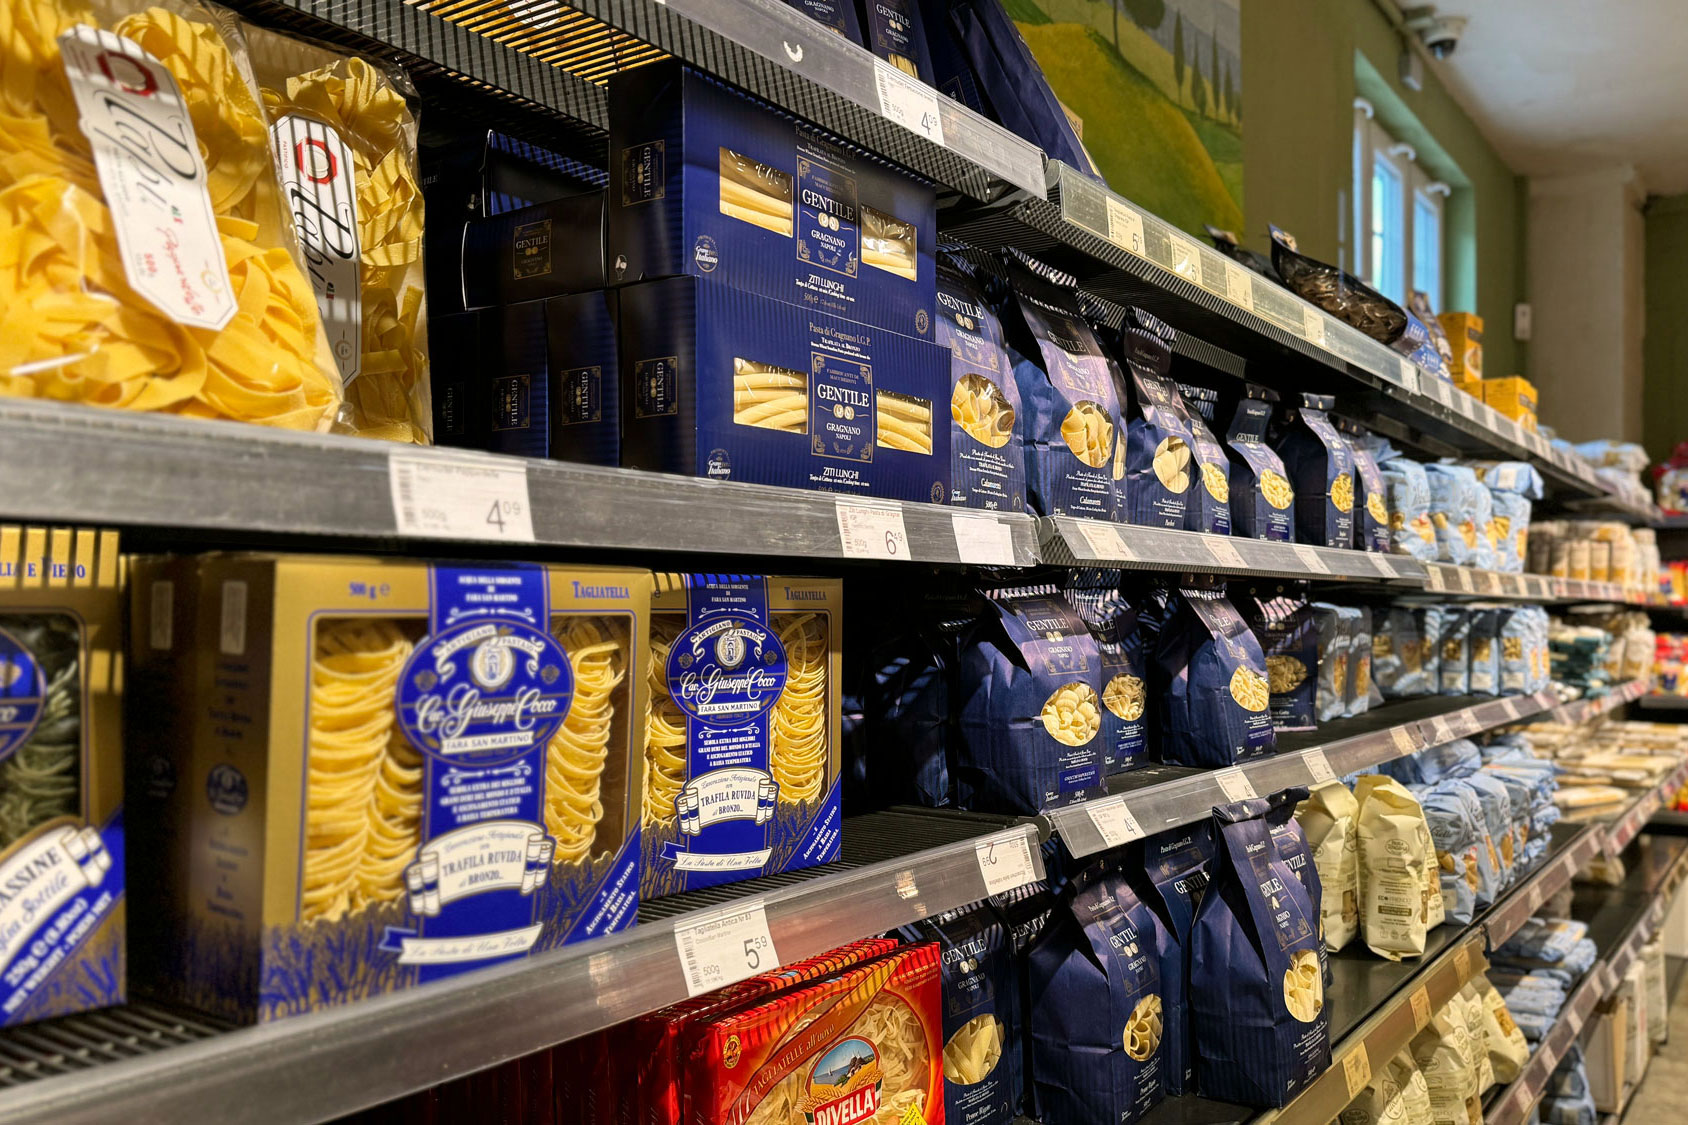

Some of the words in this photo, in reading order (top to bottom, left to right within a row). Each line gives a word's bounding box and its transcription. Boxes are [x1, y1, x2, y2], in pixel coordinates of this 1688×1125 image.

[876, 3, 911, 28] GENTILE
[643, 145, 652, 198] GENTILE
[802, 189, 854, 221] GENTILE
[515, 235, 550, 250] GENTILE
[811, 229, 846, 248] GRAGNANO
[937, 291, 984, 321] GENTILE
[809, 321, 824, 334] Pasta
[830, 328, 857, 342] Gragnano
[1047, 330, 1084, 352] GENTILE
[581, 370, 590, 421] GENTILE
[657, 361, 665, 413] GENTILE
[817, 383, 869, 408] GENTILE
[510, 378, 519, 427] GENTILE
[826, 422, 861, 436] GRAGNANO
[835, 432, 852, 441] NAPOLI
[836, 468, 859, 480] LUNGHI
[571, 580, 631, 600] TAGLIATELLA
[784, 586, 827, 601] TAGLIATELLA
[697, 621, 732, 641] ARTIGIANO
[1026, 617, 1069, 631] GENTILE
[736, 629, 760, 641] PASTAIO
[696, 663, 750, 705] Giuseppe
[746, 666, 776, 700] Cocco
[439, 683, 519, 740] Giuseppe
[515, 686, 558, 731] Cocco
[700, 704, 716, 713] FARA
[716, 703, 730, 712] SAN
[730, 702, 759, 712] MARTINO
[446, 740, 470, 750] FARA
[470, 737, 489, 748] SAN
[490, 734, 531, 747] MARTINO
[700, 790, 730, 808] TRAFILA
[731, 789, 756, 801] RUVIDA
[712, 808, 718, 817] di
[824, 805, 839, 829] STATICO
[442, 855, 486, 879] TRAFILA
[486, 849, 524, 867] RUVIDA
[680, 856, 693, 867] La
[693, 855, 716, 867] Pasta
[717, 855, 724, 866] di
[725, 855, 743, 866] Una
[744, 854, 763, 865] Volta
[1283, 852, 1307, 870] ENTILE
[694, 923, 721, 935] Tagliatella
[721, 916, 738, 928] Antica
[942, 938, 987, 966] GENTILE
[703, 964, 721, 976] 500g
[957, 972, 986, 991] GRAGNANO
[752, 1043, 805, 1096] TAGLIATELLE
[805, 1024, 835, 1050] all'uovo
[816, 1088, 875, 1125] DIVELLA
